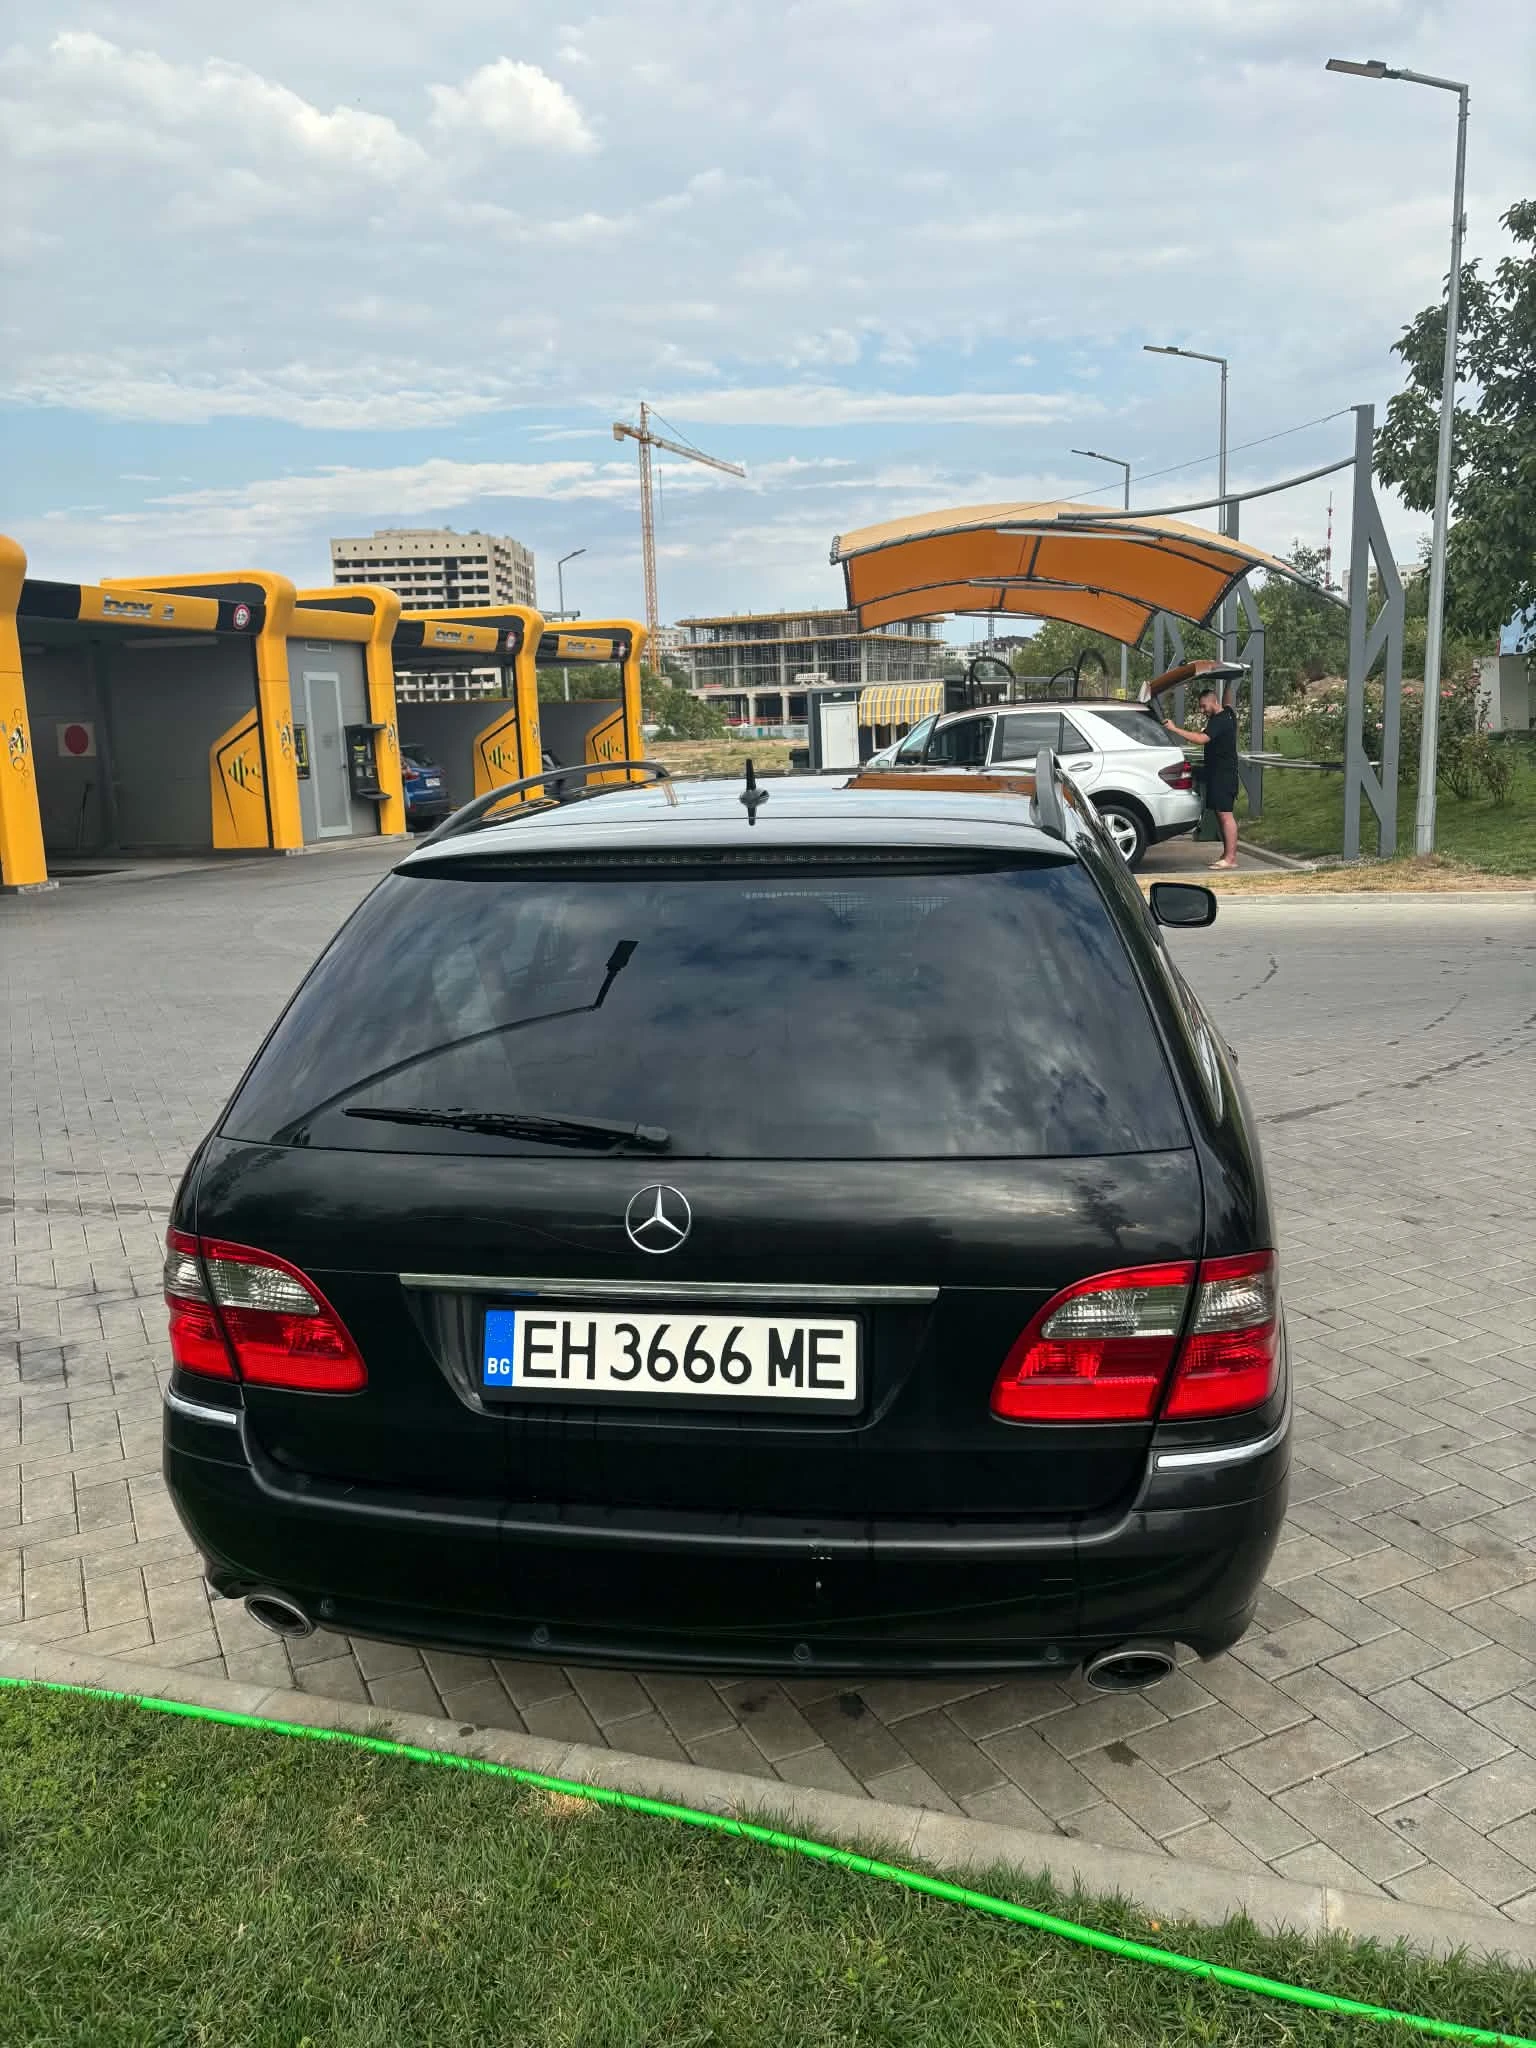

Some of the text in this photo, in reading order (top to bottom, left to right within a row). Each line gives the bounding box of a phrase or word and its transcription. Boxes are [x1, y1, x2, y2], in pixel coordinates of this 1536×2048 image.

[487, 1356, 510, 1375] BG
[522, 1319, 845, 1390] EH 3666 ME
